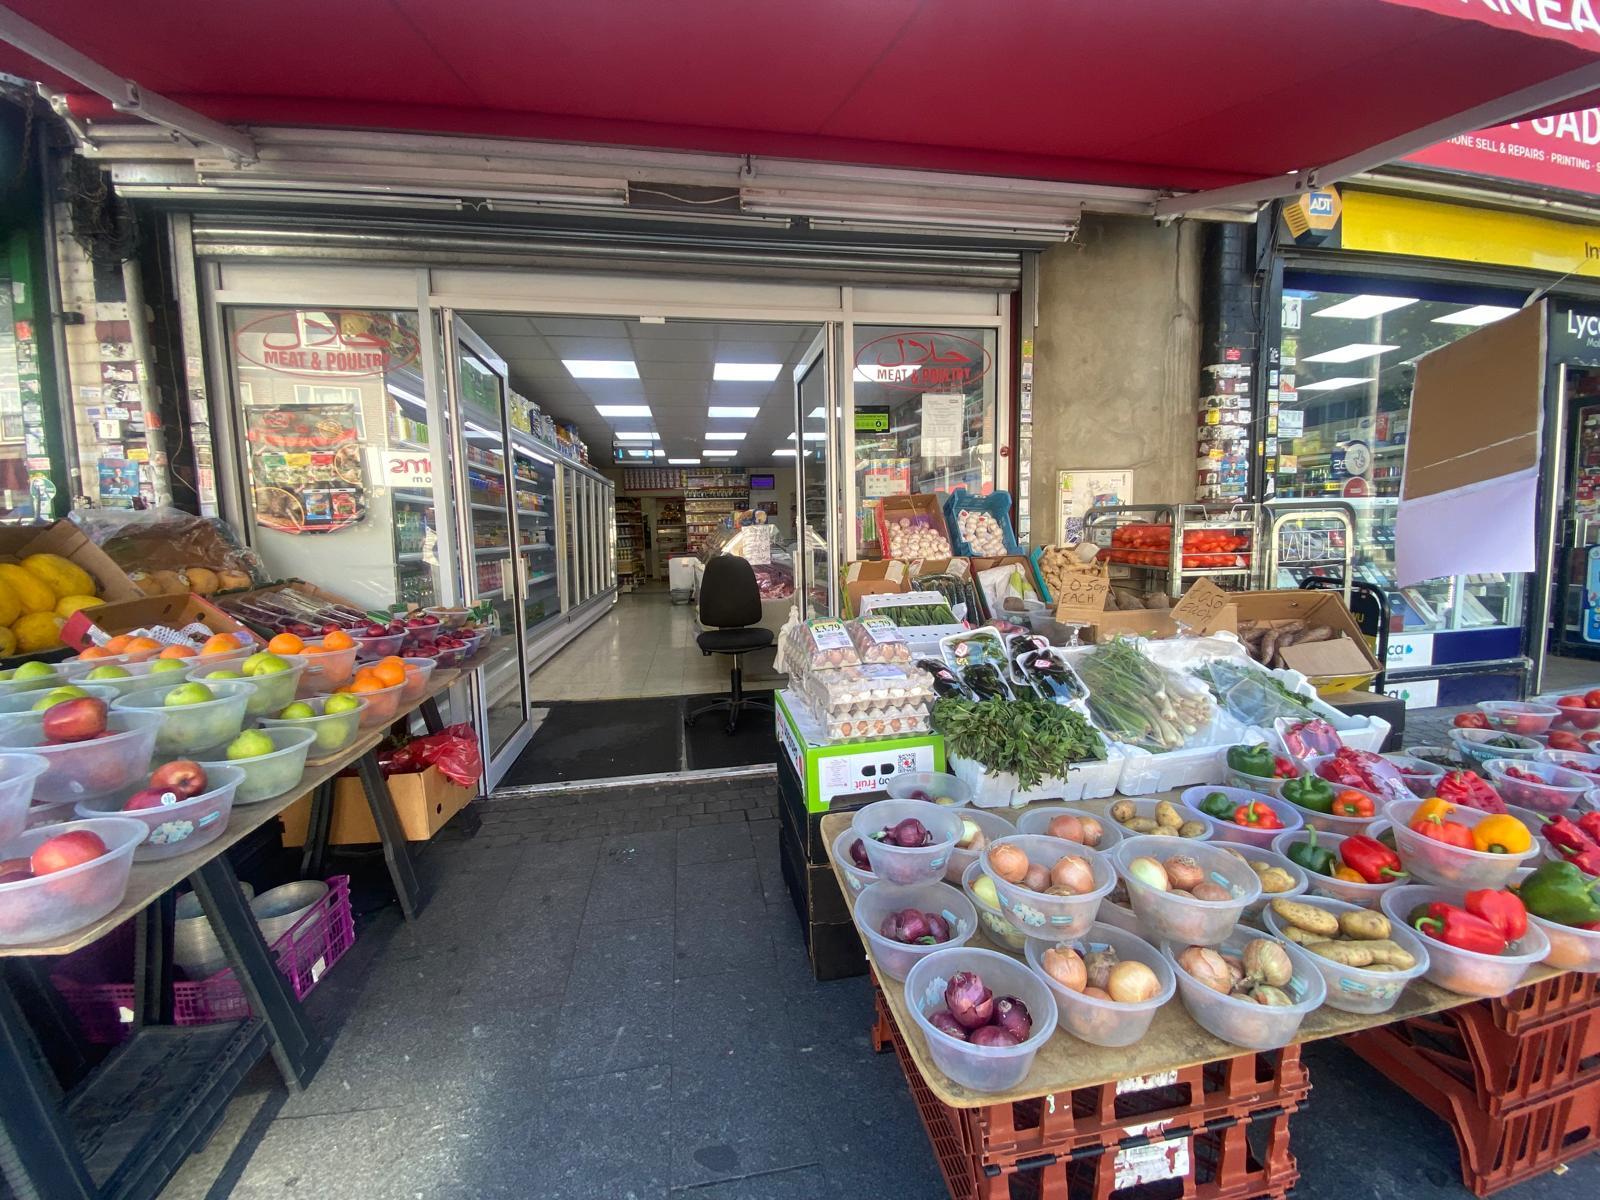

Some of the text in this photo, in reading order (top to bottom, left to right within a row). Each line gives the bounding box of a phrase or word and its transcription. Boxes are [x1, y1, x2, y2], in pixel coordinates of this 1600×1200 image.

[1475, 138, 1498, 152] SELL
[1499, 143, 1506, 153] &
[1508, 144, 1545, 161] REPAIRS
[1551, 153, 1590, 170] PRINTING
[1310, 197, 1333, 211] ADT
[264, 351, 390, 371] MEAT & POULTRY
[877, 367, 971, 384] MEAT & POULTRY
[1062, 593, 1094, 604] EACH
[814, 623, 841, 633] £3.79
[855, 779, 876, 791] Fruit
